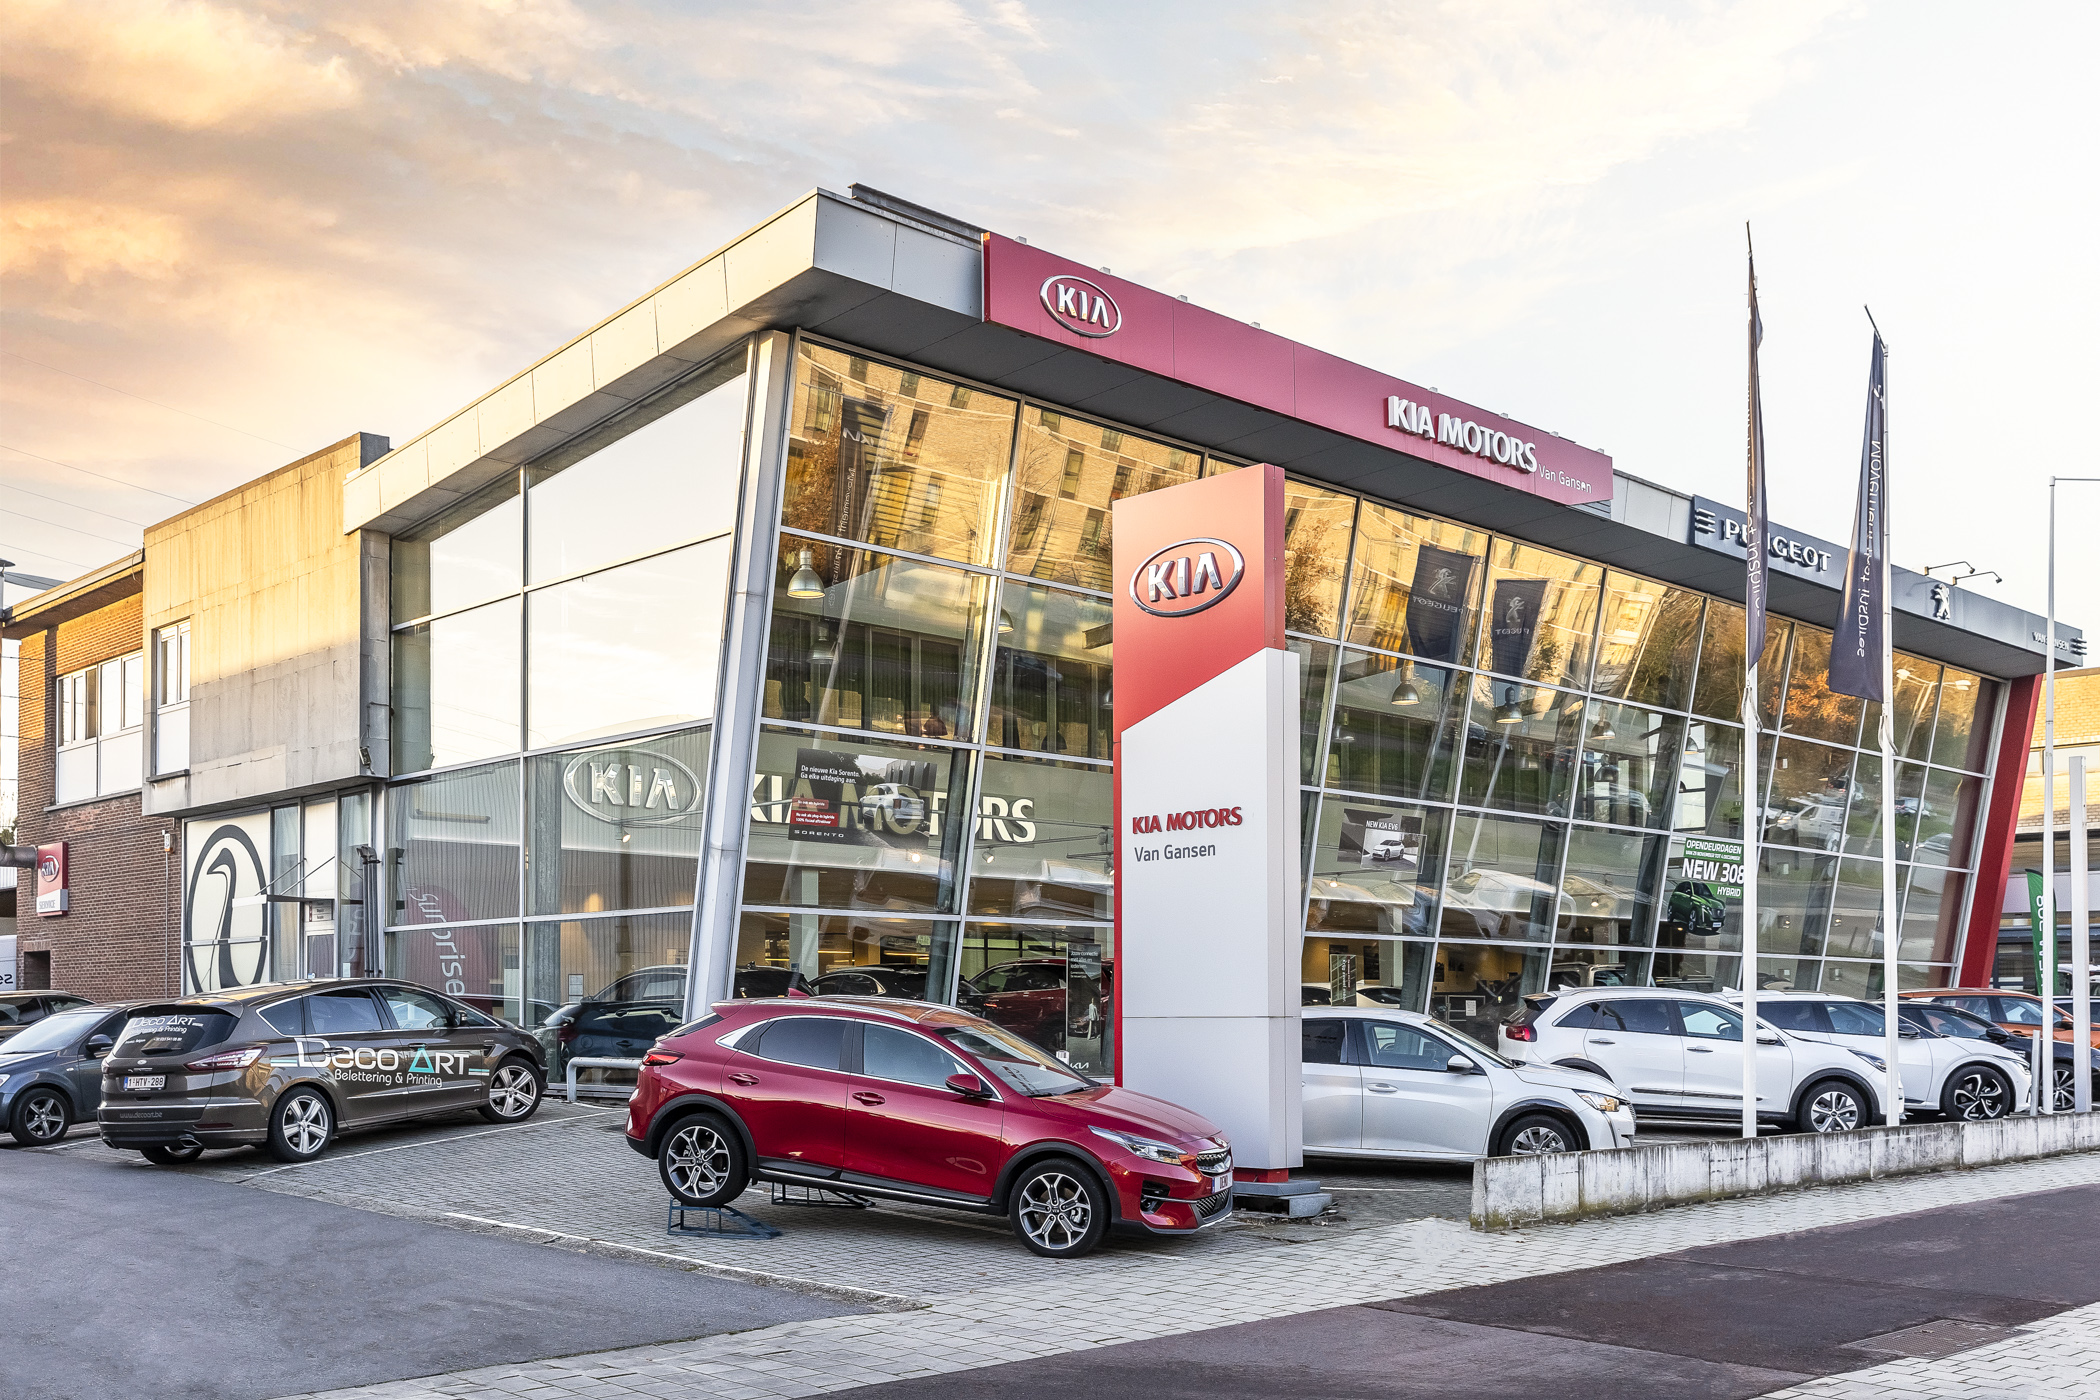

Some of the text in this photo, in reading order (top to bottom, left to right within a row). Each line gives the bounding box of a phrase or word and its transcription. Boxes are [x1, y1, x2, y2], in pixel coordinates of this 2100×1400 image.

[1056, 283, 1109, 328] KIA
[1388, 395, 1537, 473] KIA MOTORS
[1539, 463, 1592, 493] Van Gansen
[1725, 518, 1831, 572] PGEOT
[1148, 551, 1223, 603] KIA
[800, 772, 808, 780] Ga
[820, 774, 845, 784] uitdaging
[801, 764, 809, 772] De
[810, 766, 828, 774] nieuwe
[829, 767, 838, 775] Kia
[590, 762, 679, 810] KIA
[839, 783, 1036, 843] MOTRS
[1132, 806, 1243, 834] KIA MOTORS
[1366, 820, 1378, 829] NEW
[1378, 821, 1388, 829] KIA
[794, 829, 845, 838] SORENTO
[1134, 844, 1216, 862] Van Gansen
[1686, 839, 1742, 854] OPENDEURDAGEN
[1681, 858, 1744, 884] NEW 308
[1717, 886, 1741, 897] HYBRID
[164, 1026, 187, 1034] Printing
[335, 1068, 442, 1088] Belettering & Printing
